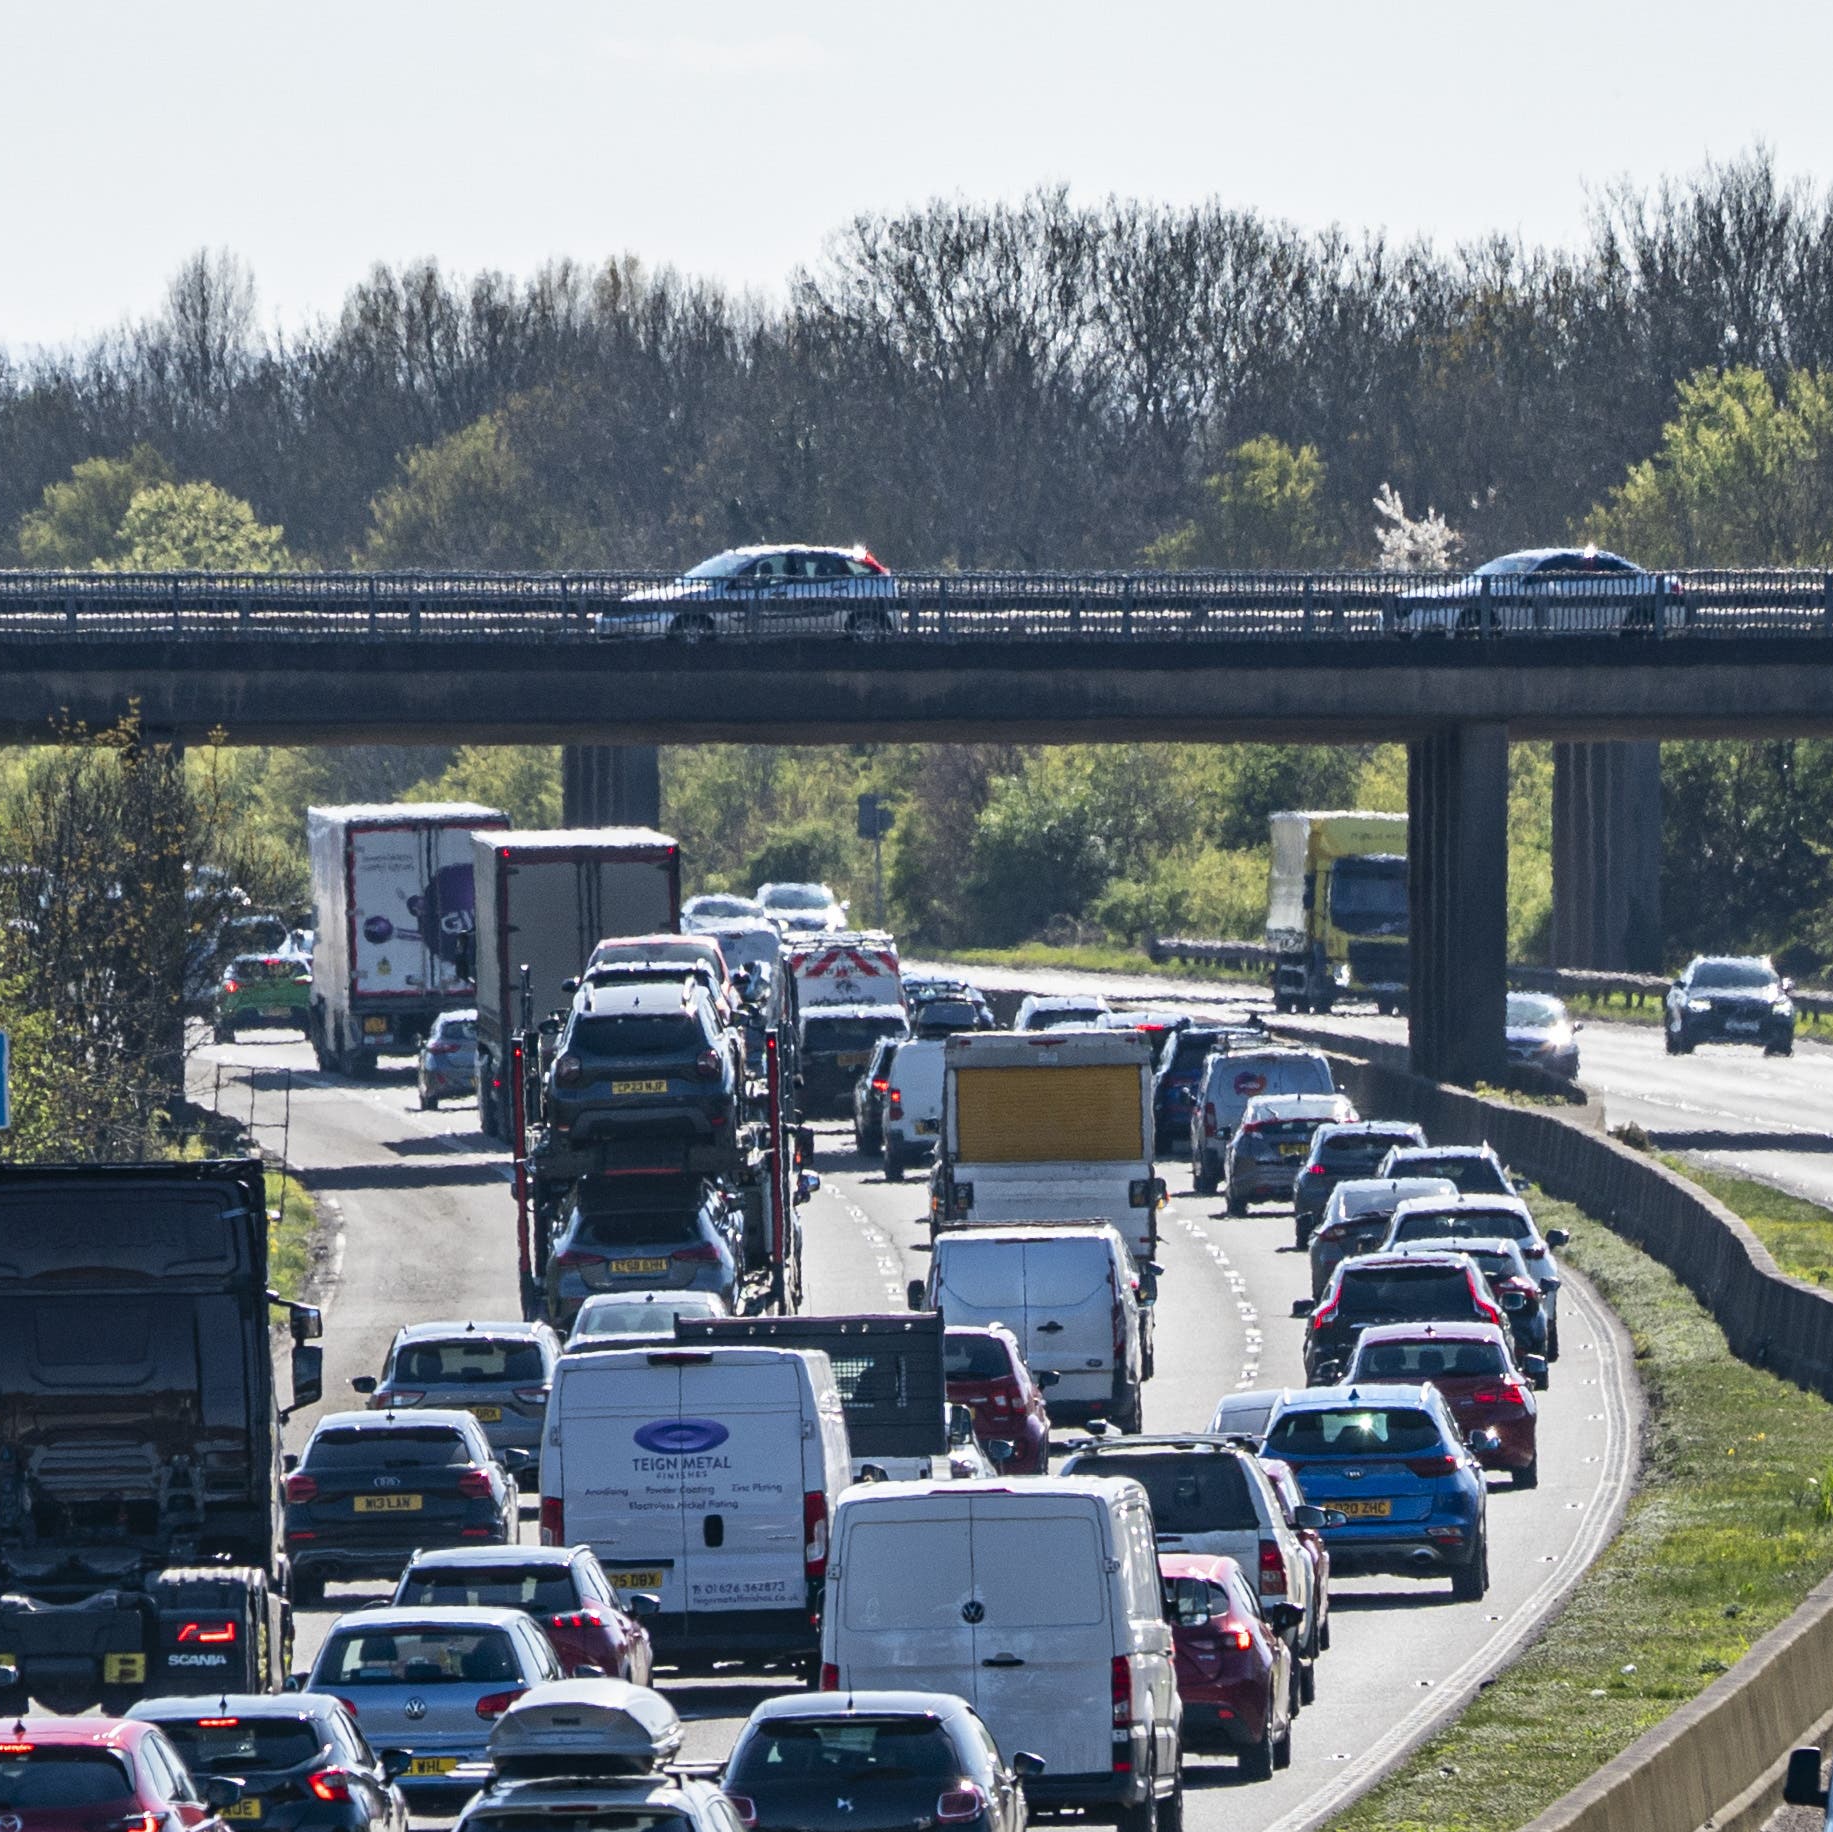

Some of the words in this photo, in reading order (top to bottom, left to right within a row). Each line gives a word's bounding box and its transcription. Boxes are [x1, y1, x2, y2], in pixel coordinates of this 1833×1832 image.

[632, 1457, 676, 1472] TEIGN
[682, 1456, 732, 1471] METAL
[167, 1654, 228, 1666] SCANIA
